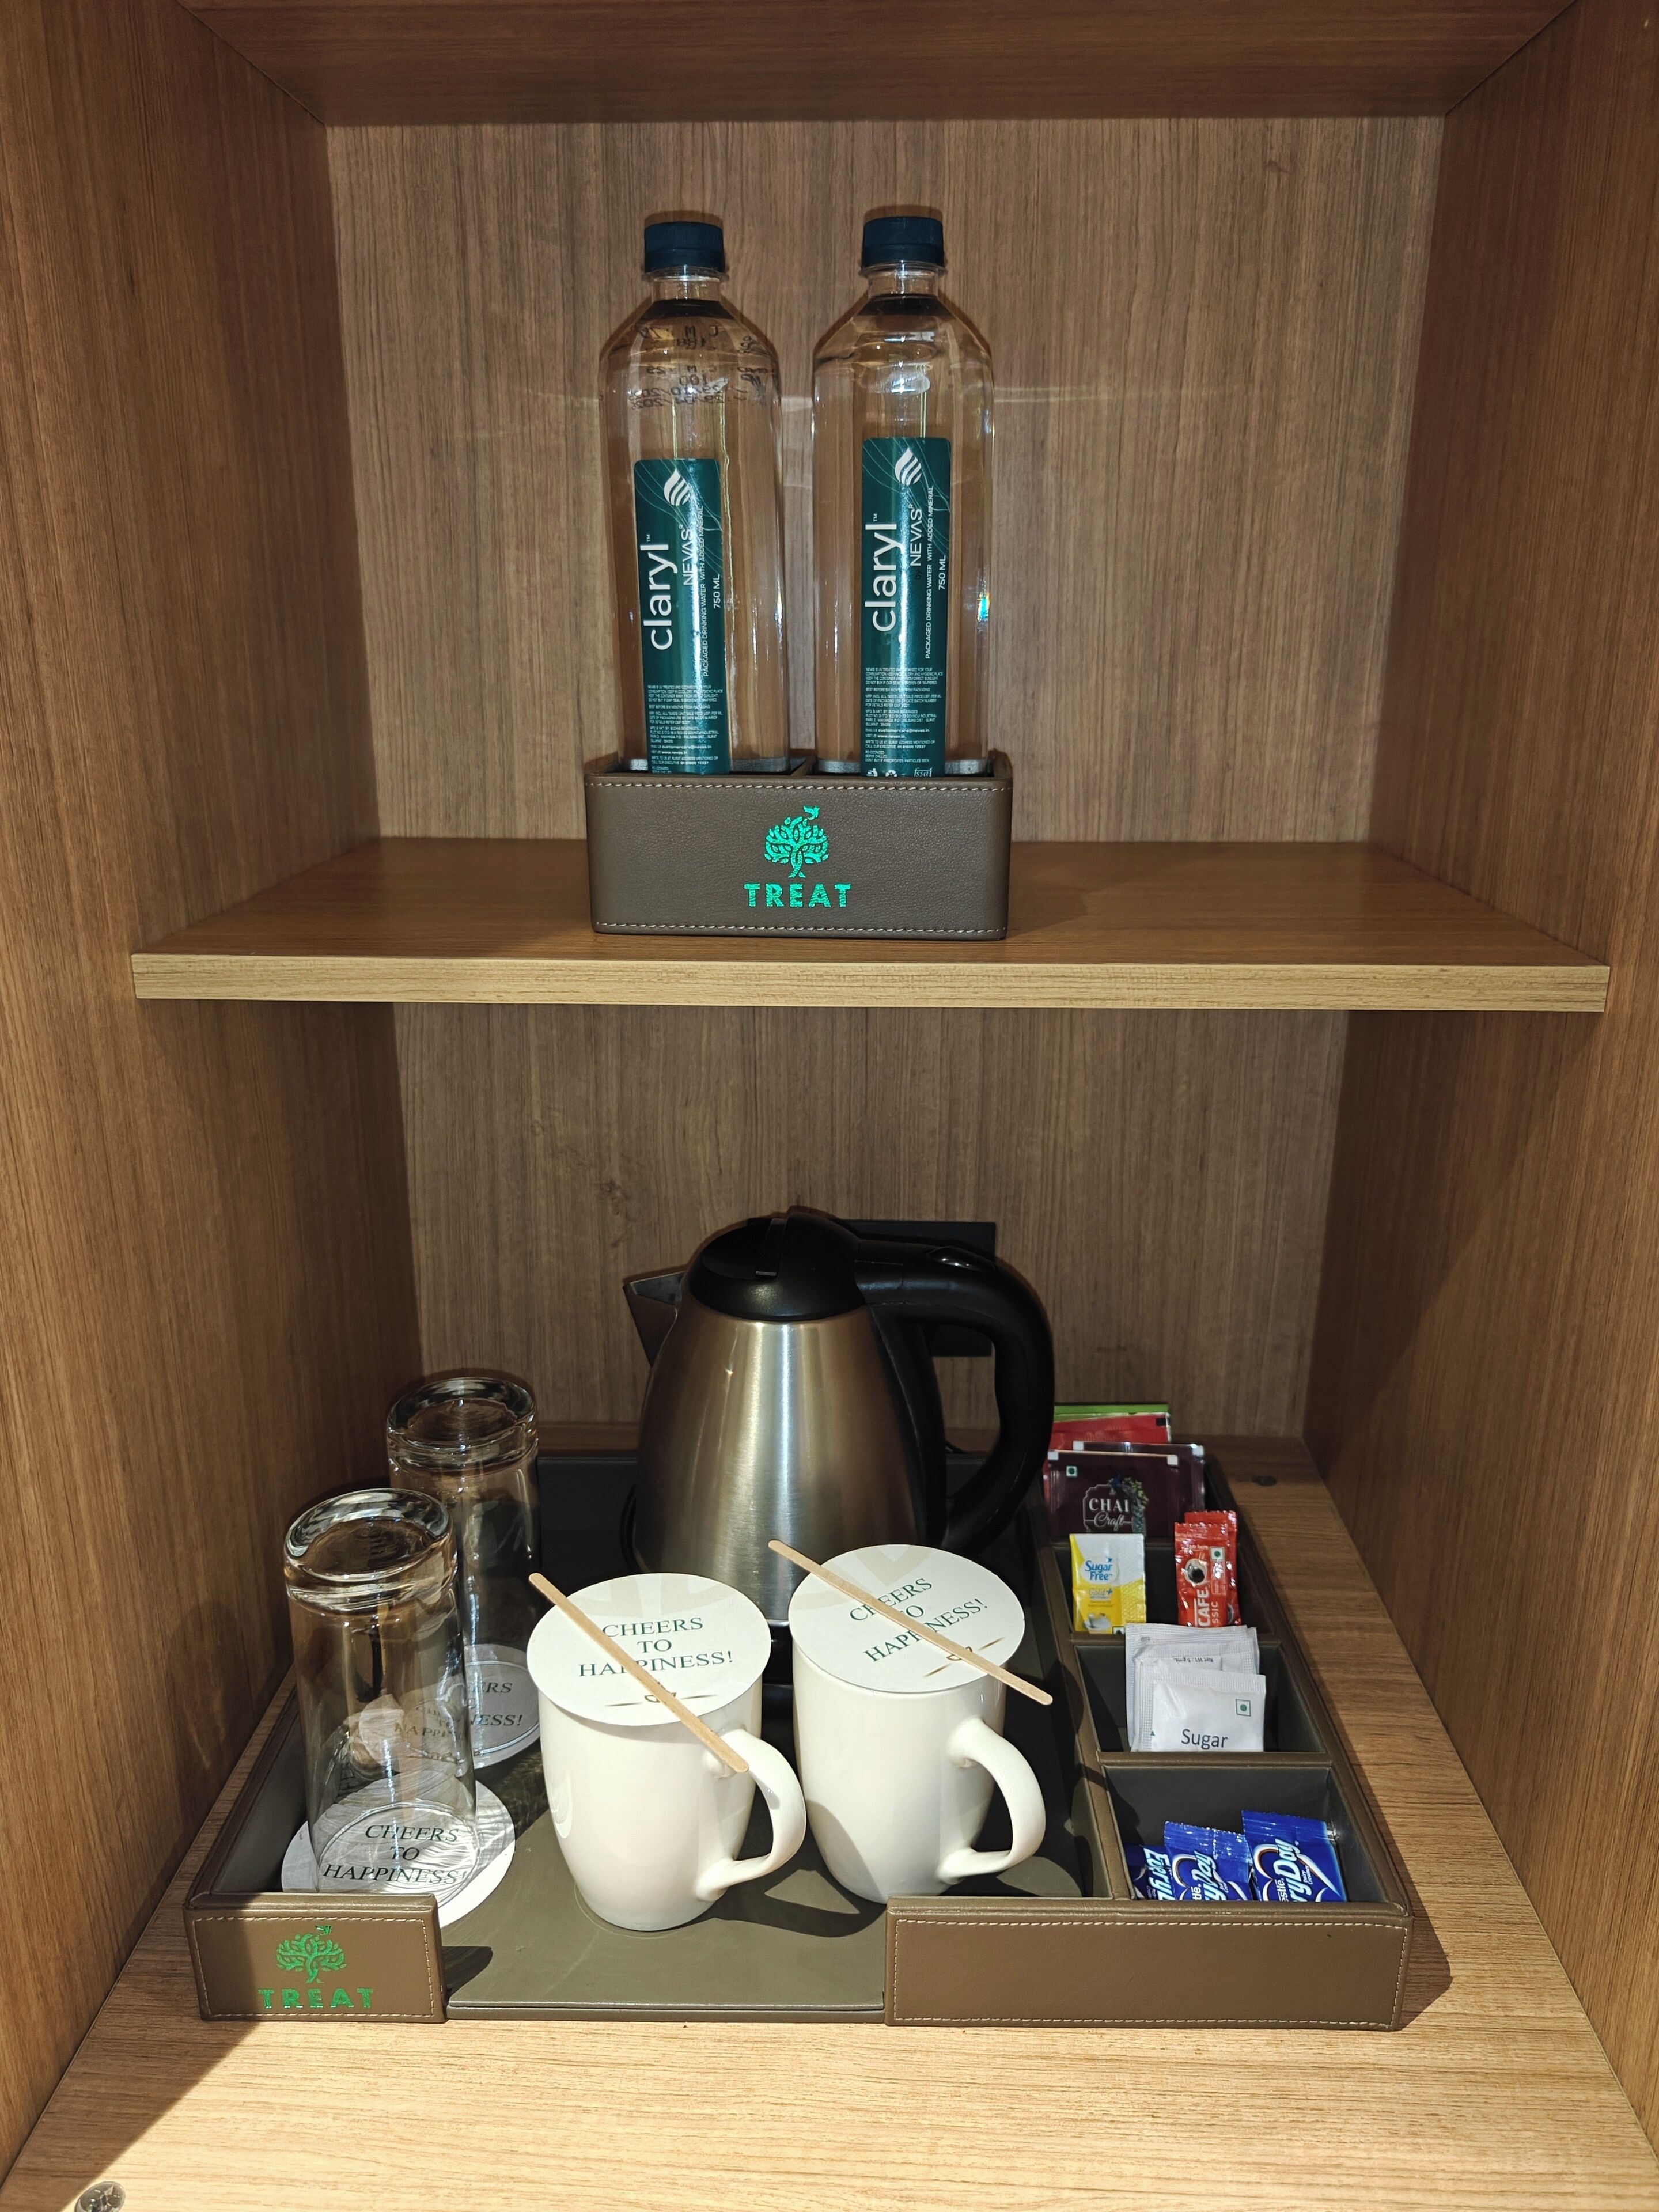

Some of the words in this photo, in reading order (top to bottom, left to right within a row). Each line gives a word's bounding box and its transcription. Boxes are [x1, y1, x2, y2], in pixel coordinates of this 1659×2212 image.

[910, 508, 922, 566] NEVAS
[938, 555, 946, 570] ML
[713, 574, 721, 589] ML
[865, 524, 905, 632] claryl
[640, 544, 678, 650] claryl
[744, 883, 851, 907] TREAT
[1089, 1498, 1130, 1512] CHAI
[1094, 1510, 1125, 1532] Craft
[1085, 1559, 1113, 1573] Sugar
[1089, 1571, 1109, 1581] Free
[899, 1604, 925, 1618] O
[602, 1616, 704, 1637] CHEERS
[637, 1639, 672, 1653] TO
[1181, 1728, 1228, 1750] Sugar
[365, 1824, 459, 1843] CHEERS
[389, 1846, 421, 1861] TO
[258, 1988, 374, 2009] TREAT
